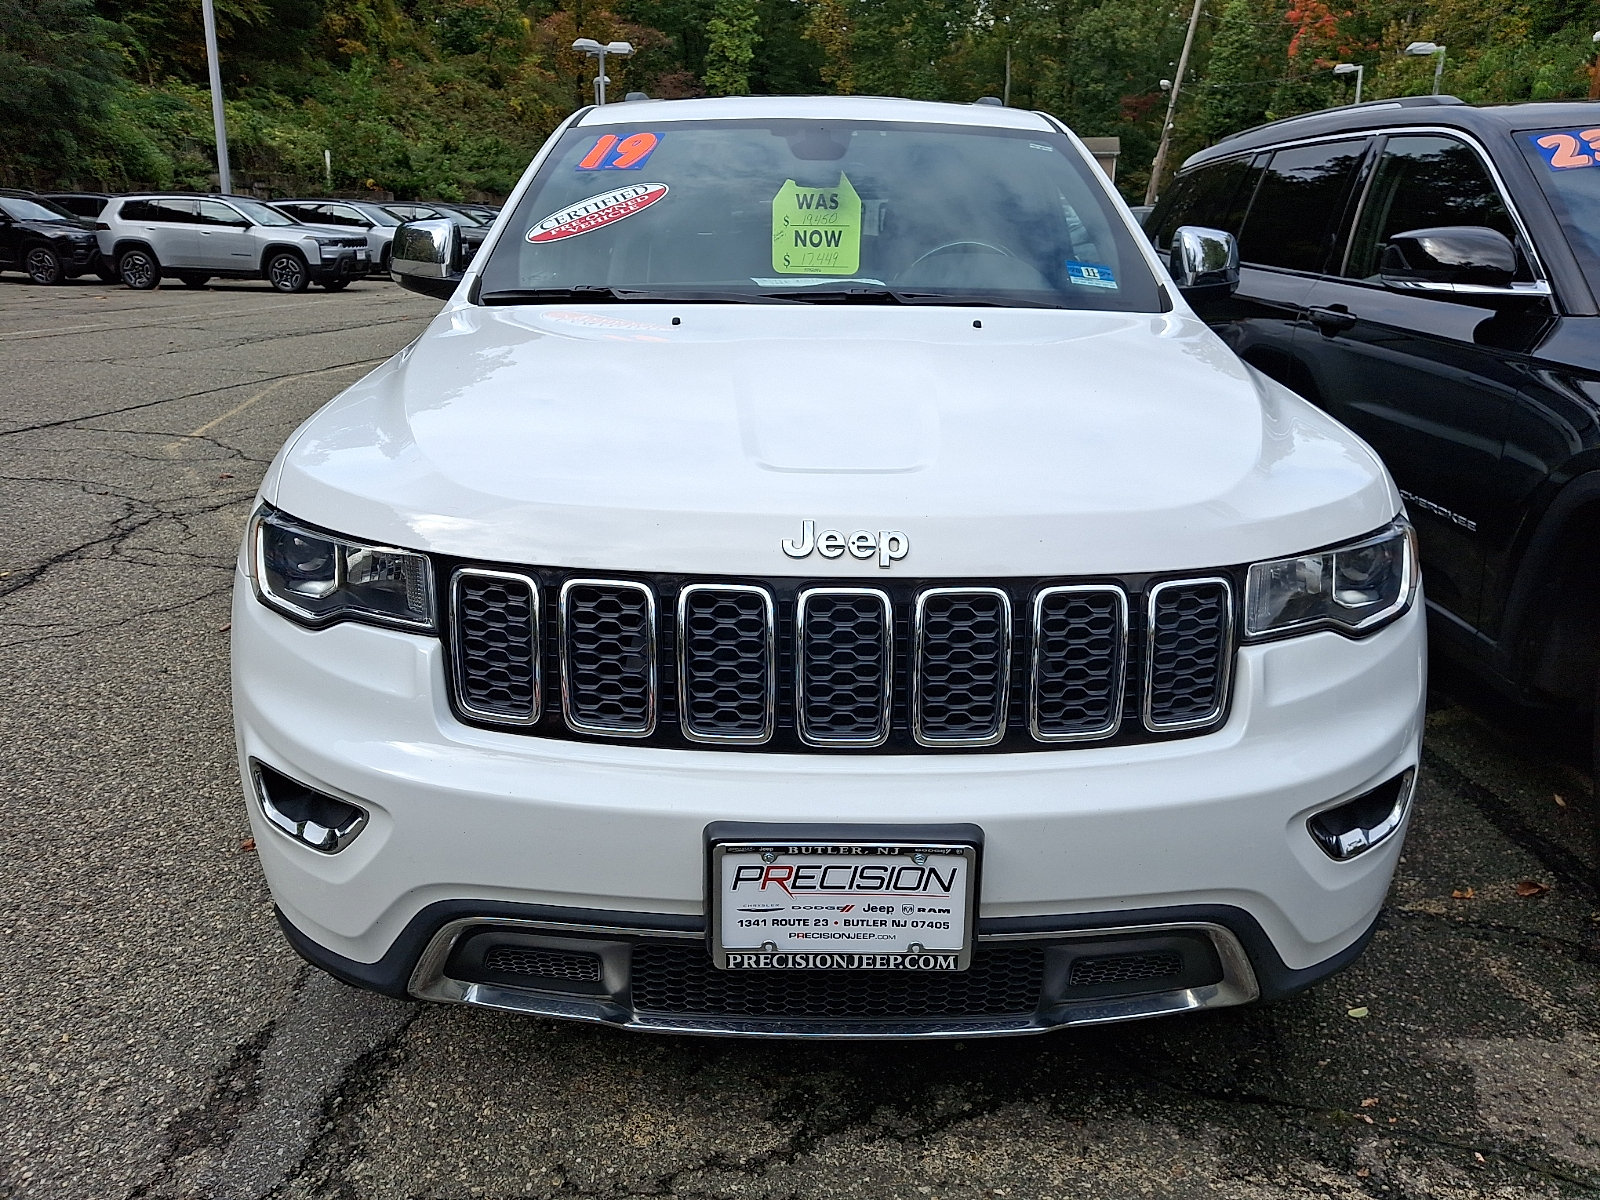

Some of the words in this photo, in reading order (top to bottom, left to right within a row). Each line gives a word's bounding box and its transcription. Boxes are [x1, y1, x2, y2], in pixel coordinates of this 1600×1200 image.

[579, 132, 658, 169] 19
[540, 185, 649, 231] CERTIFIED
[796, 194, 839, 210] WAS
[550, 194, 649, 236] PRE-OWNED
[568, 202, 641, 233] VEHICLE
[783, 214, 790, 228] $
[794, 229, 843, 247] NOW
[783, 252, 791, 268] $
[1085, 268, 1098, 277] 11
[781, 519, 910, 569] Jeep
[788, 846, 869, 855] BUTLER,
[877, 847, 901, 855] NJ
[731, 864, 958, 899] PRECISION
[862, 903, 895, 914] Jeep
[737, 919, 767, 928] 1341
[771, 918, 810, 927] ROUTE
[813, 918, 829, 927] 23
[843, 919, 888, 928] BUTLER
[891, 919, 908, 928] NJ
[911, 920, 950, 930] 07405
[788, 932, 897, 940] PRECISIONJEEP.COM
[727, 953, 957, 970] PRECISIONJEEP.COM
